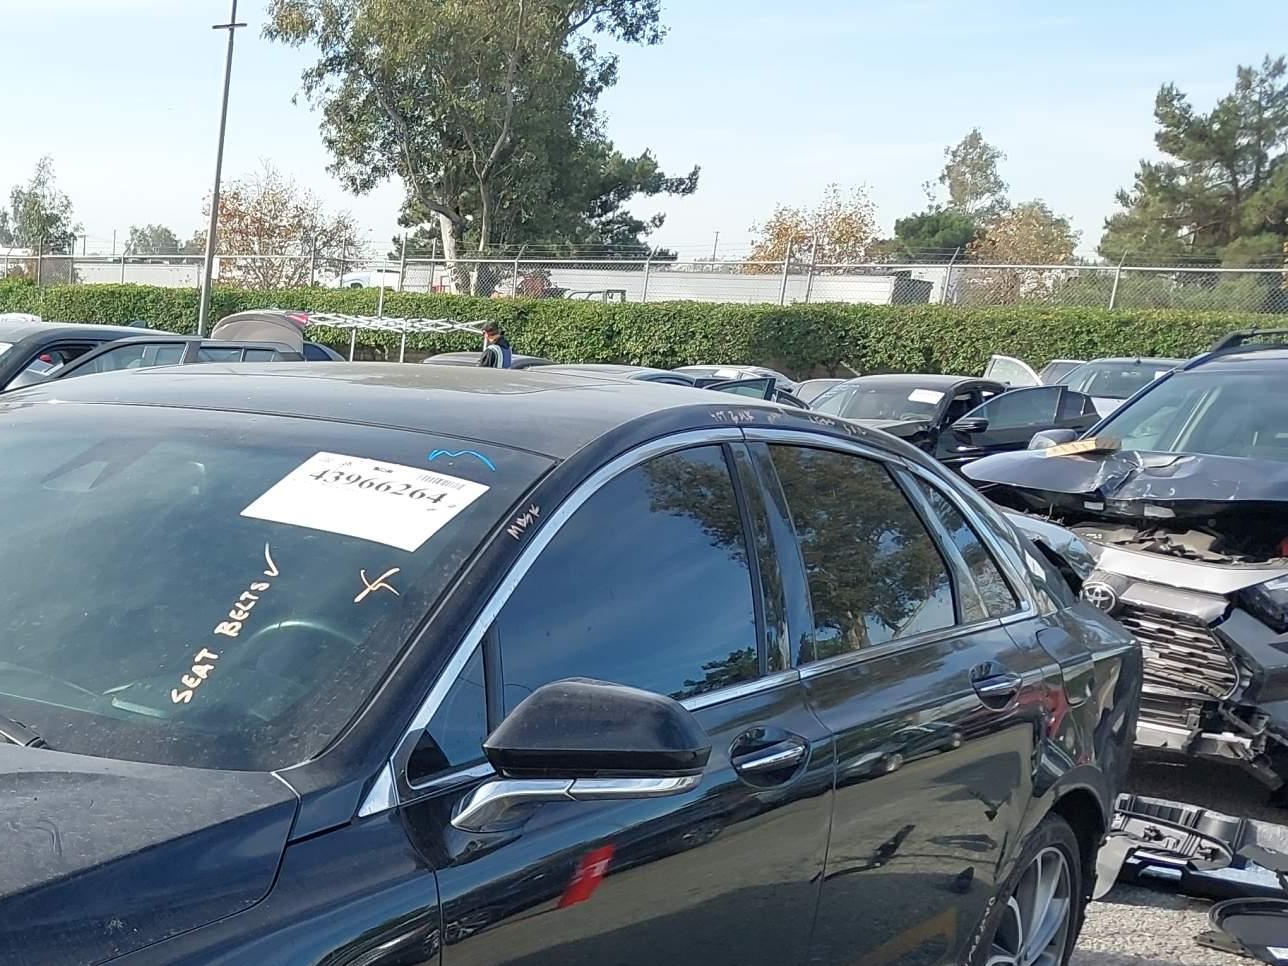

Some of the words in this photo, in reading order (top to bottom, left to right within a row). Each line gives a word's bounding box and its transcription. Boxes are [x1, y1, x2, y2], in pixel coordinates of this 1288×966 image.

[309, 468, 448, 504] 43966264
[170, 648, 219, 704] SEAT
[213, 581, 271, 637] BELTS
